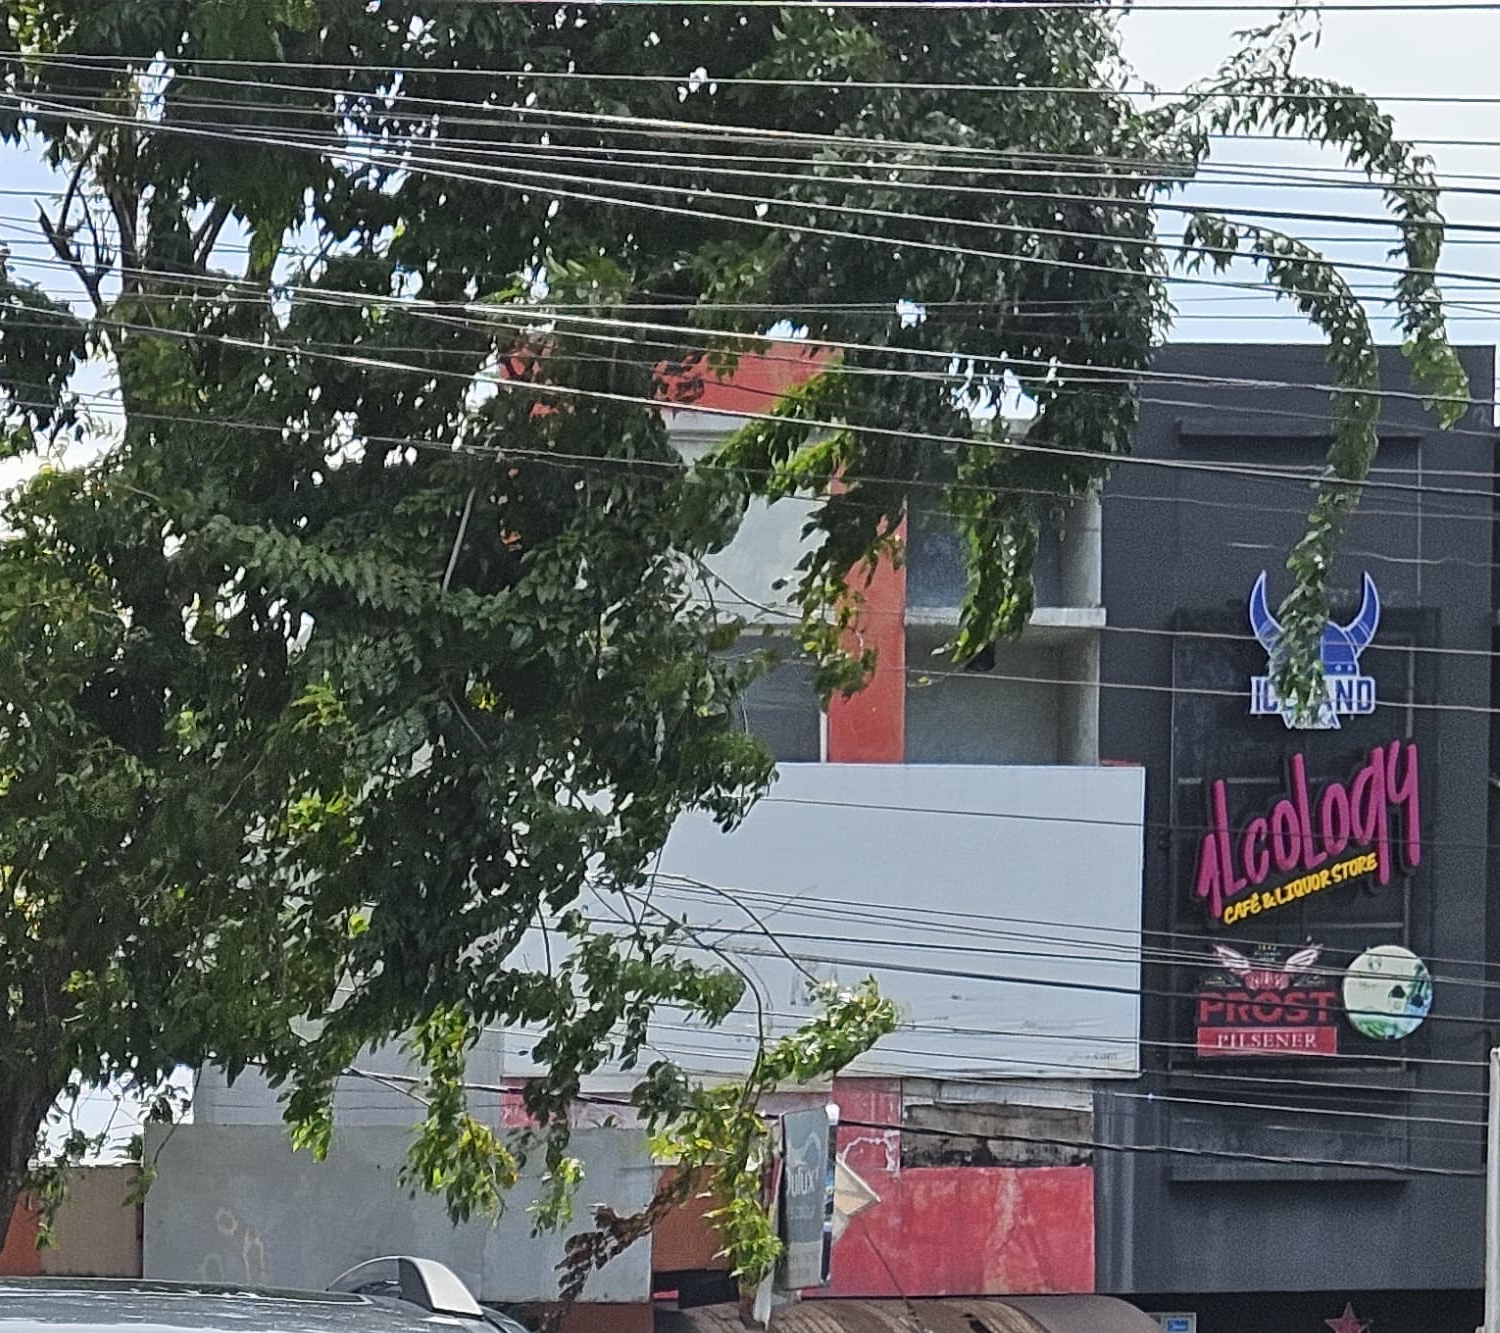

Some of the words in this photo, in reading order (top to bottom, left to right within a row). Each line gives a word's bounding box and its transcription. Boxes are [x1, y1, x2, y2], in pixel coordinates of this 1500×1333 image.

[1255, 679, 1373, 711] ICND
[1261, 891, 1277, 909] &
[1276, 868, 1332, 905] LIQUOR
[1330, 851, 1378, 883] STORE
[1199, 990, 1337, 1024] PROST
[1217, 1032, 1317, 1050] PILSENER
